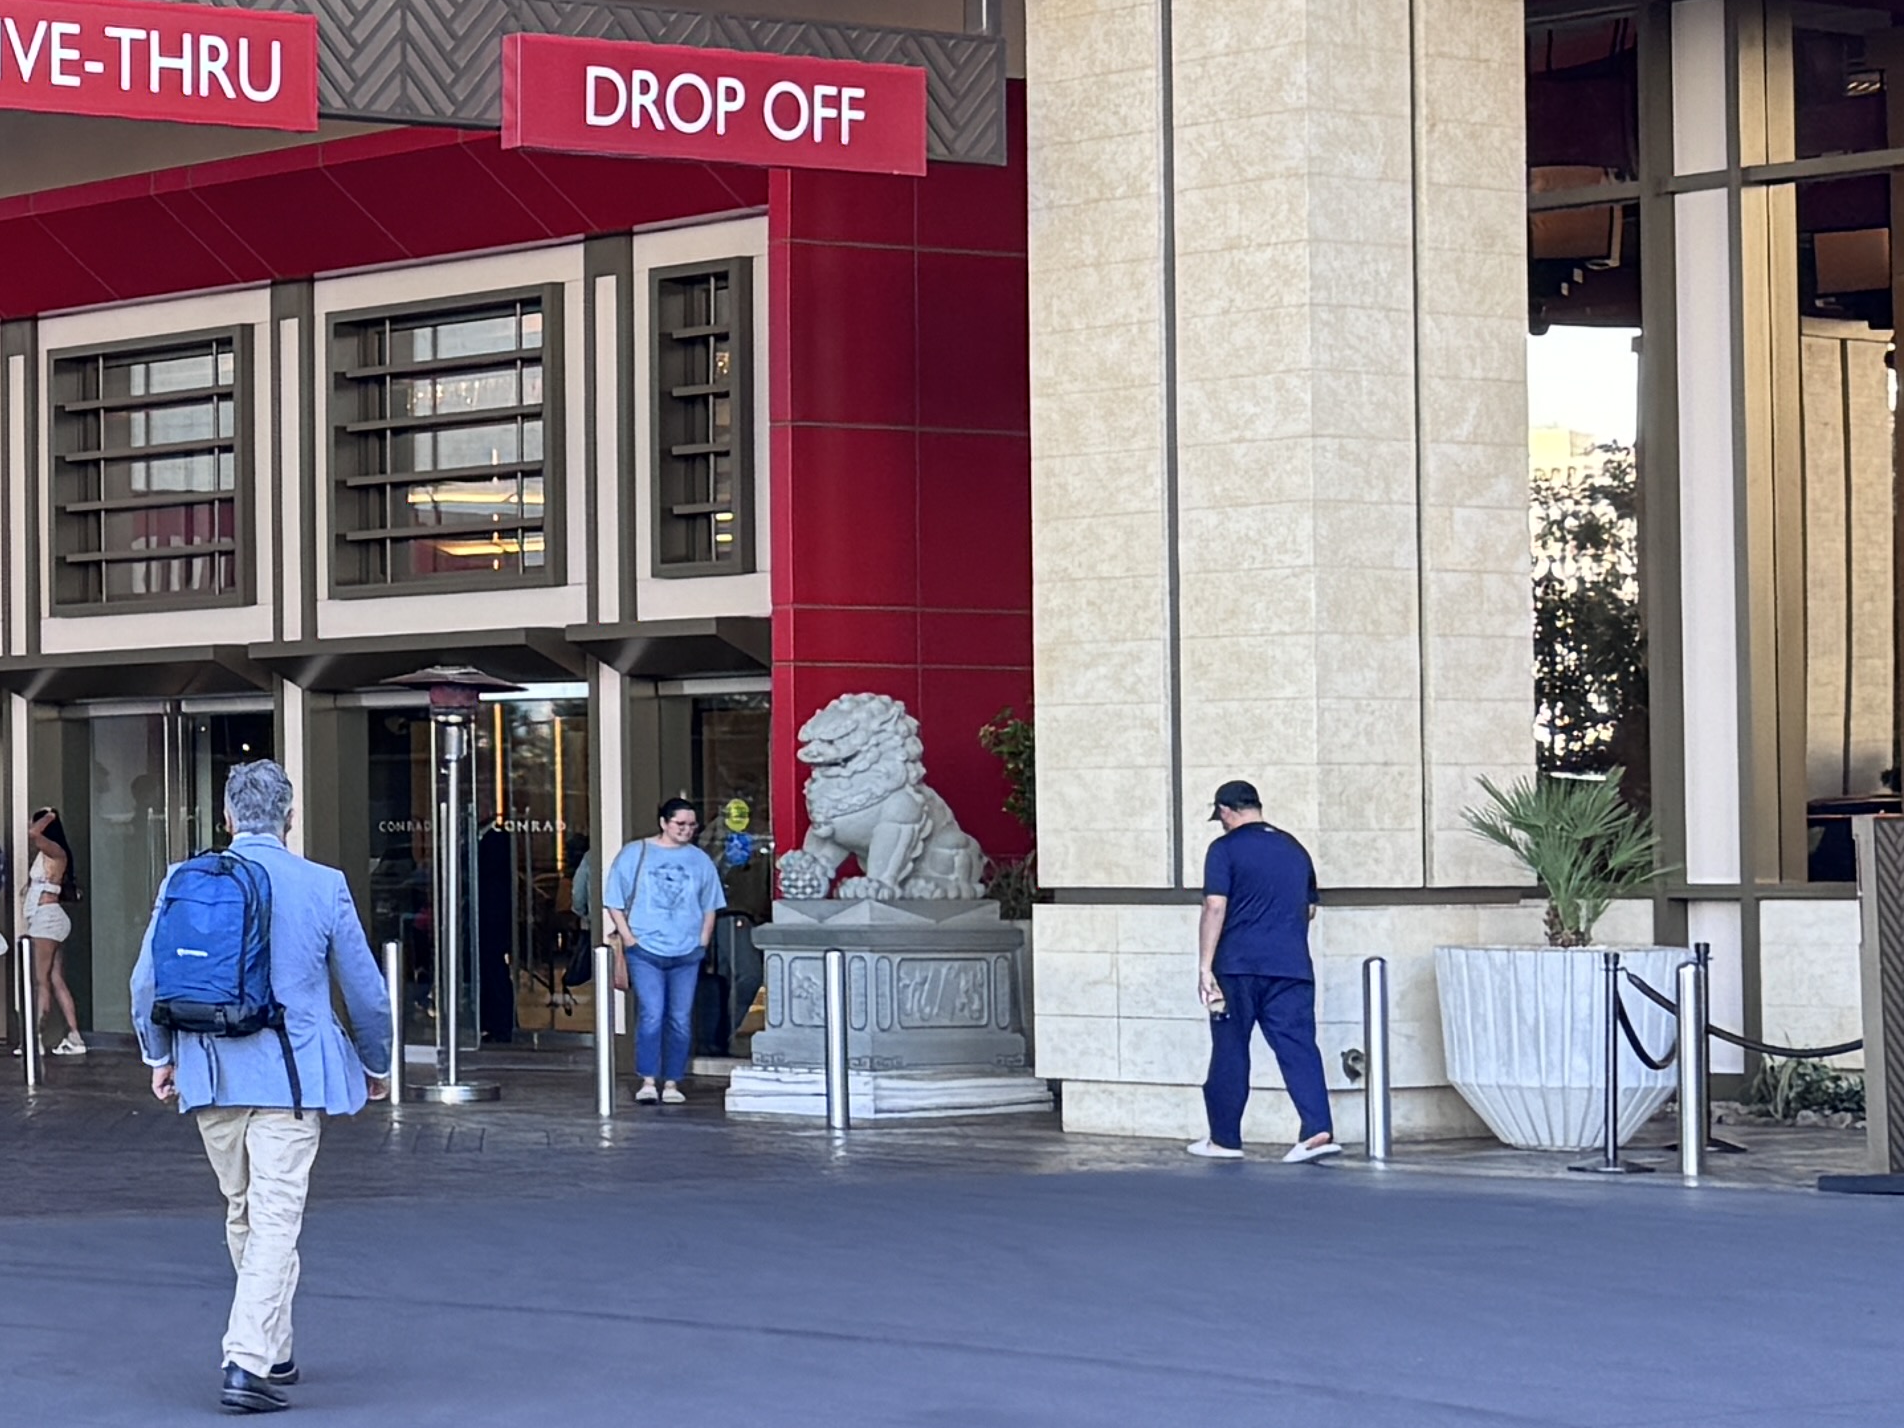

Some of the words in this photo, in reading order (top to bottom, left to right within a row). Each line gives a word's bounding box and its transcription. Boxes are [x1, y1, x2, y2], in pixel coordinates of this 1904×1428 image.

[584, 65, 746, 135] DROP
[763, 81, 866, 145] OFF
[378, 820, 432, 833] CONRAD
[492, 819, 567, 833] CONRAD
